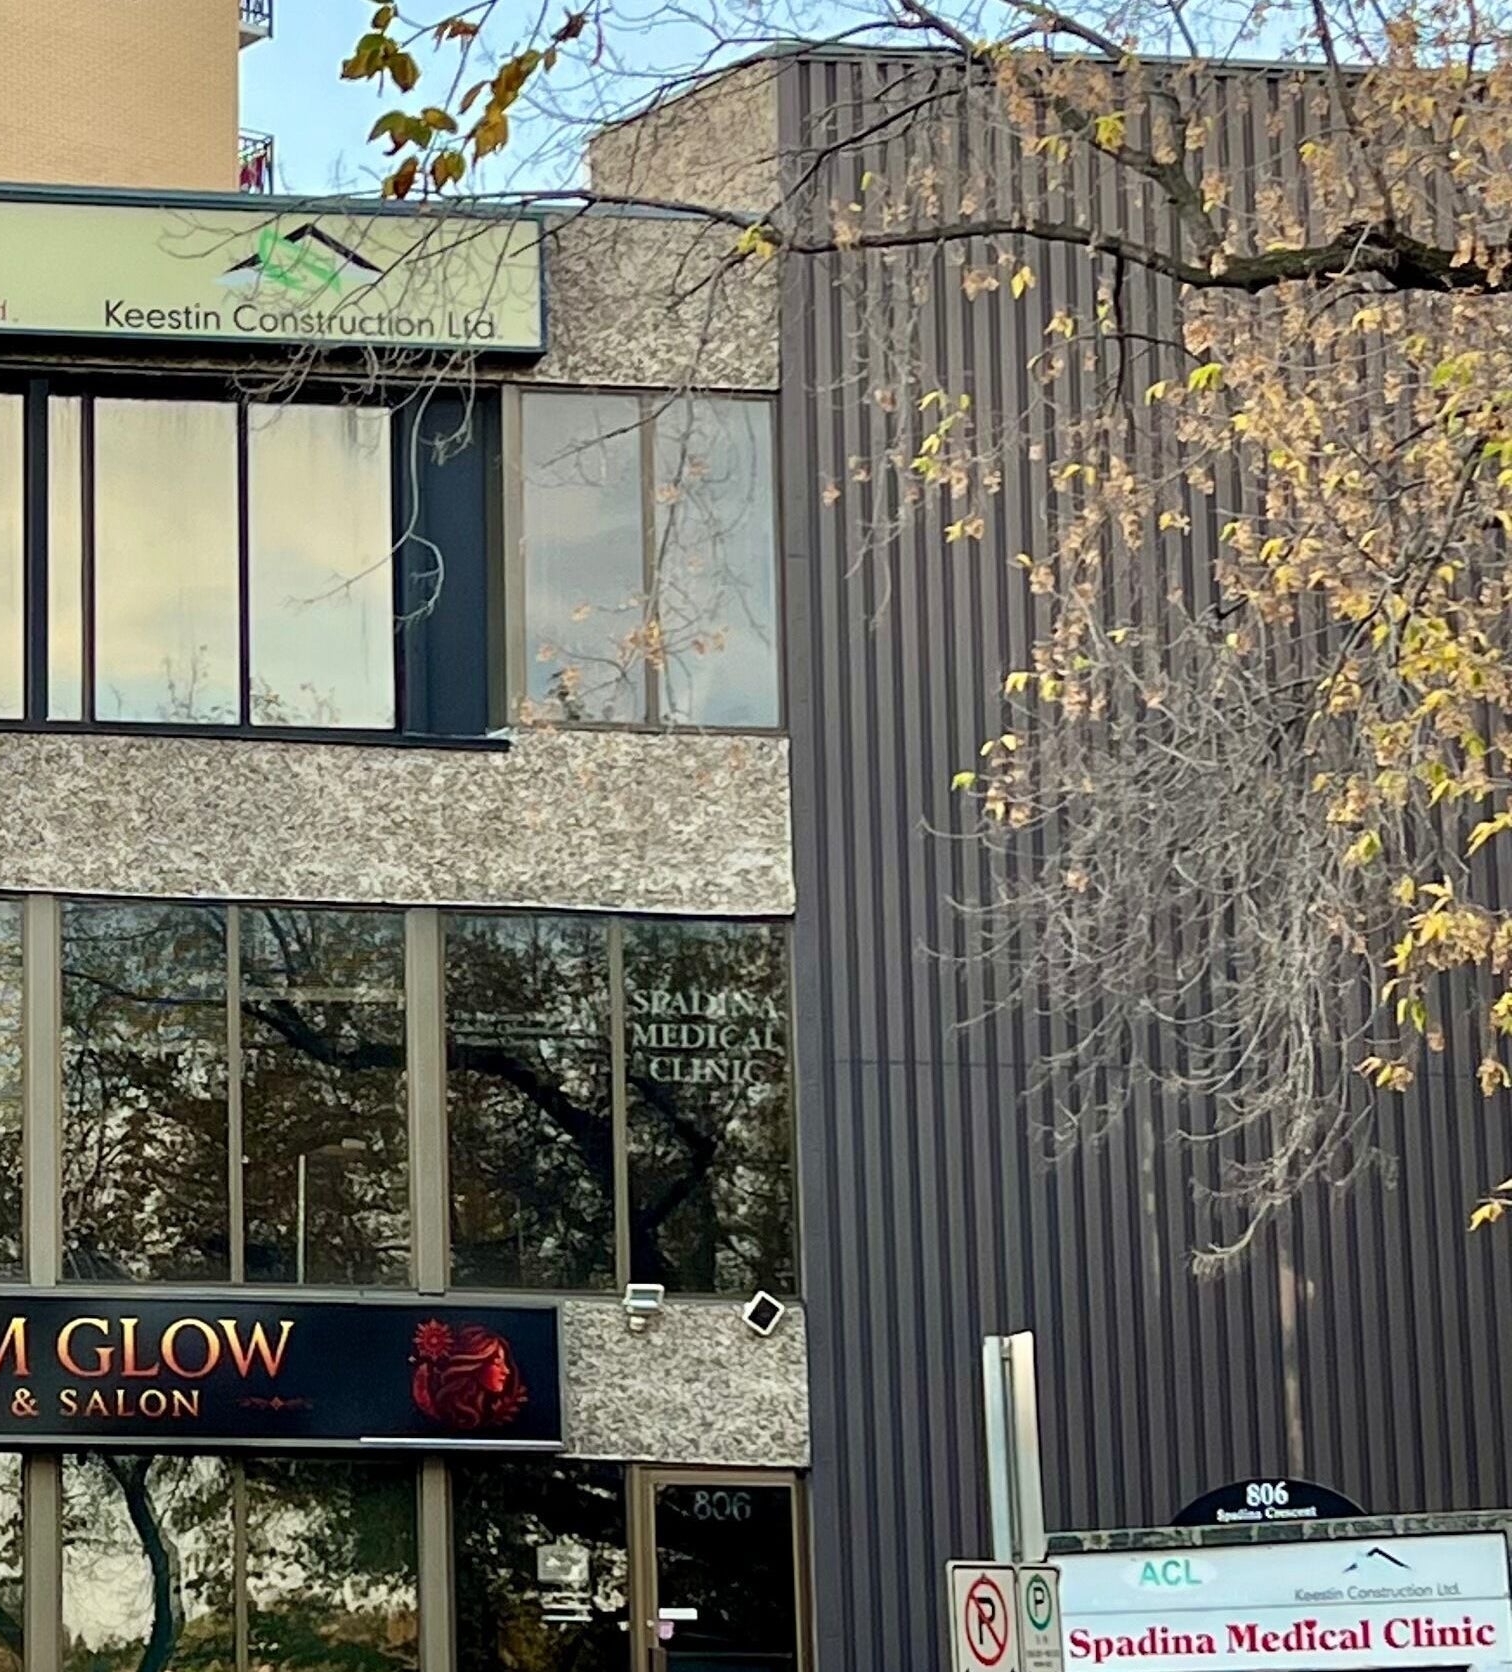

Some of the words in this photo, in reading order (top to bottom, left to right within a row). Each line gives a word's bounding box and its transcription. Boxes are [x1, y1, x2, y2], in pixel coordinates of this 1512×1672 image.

[105, 300, 220, 331] Keestin
[234, 304, 434, 338] Construction
[449, 311, 504, 340] Ltd.
[632, 989, 780, 1019] SPADINA
[632, 1023, 782, 1053] MEDICAL
[649, 1056, 768, 1084] CLINIC
[56, 1316, 296, 1380] GLOW
[11, 1388, 39, 1418] &
[59, 1388, 200, 1418] SALON
[694, 1490, 752, 1521] 806
[1246, 1481, 1289, 1506] 806
[1139, 1559, 1202, 1586] ACL
[1294, 1587, 1343, 1602] Keestin
[1347, 1584, 1433, 1600] Construction
[1069, 1626, 1216, 1664] Spadina
[1226, 1620, 1372, 1654] Medical
[1383, 1616, 1497, 1649] Clinic
